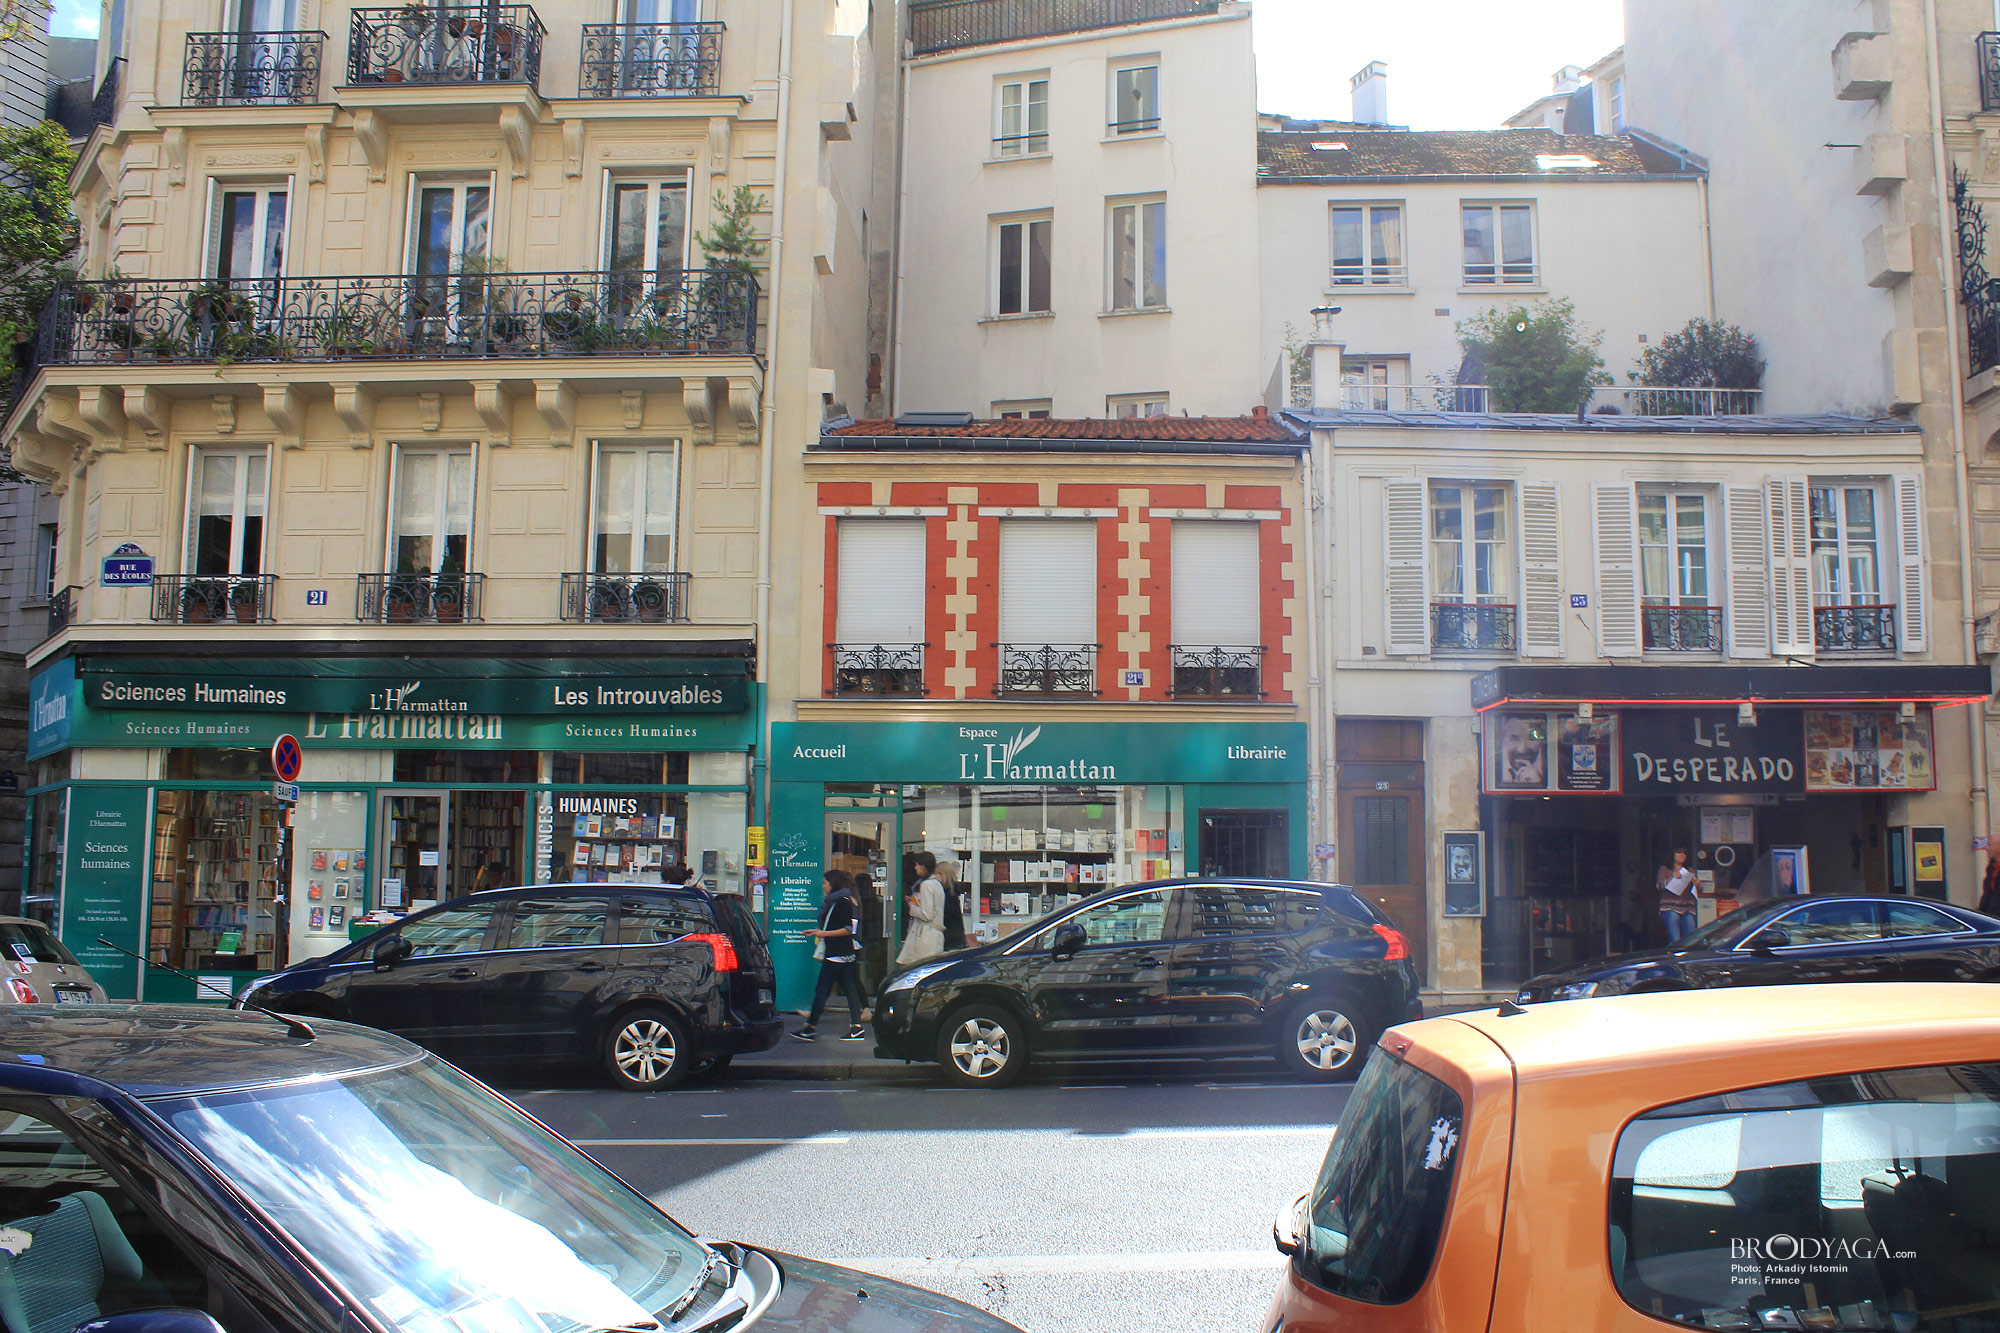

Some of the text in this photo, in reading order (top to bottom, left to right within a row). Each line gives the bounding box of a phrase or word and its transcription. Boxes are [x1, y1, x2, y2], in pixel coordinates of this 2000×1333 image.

[104, 570, 151, 580] DES ÉCOLES
[309, 591, 325, 604] 21
[101, 681, 287, 705] Sciences Humaines
[369, 687, 468, 712] L'Harmattan
[554, 684, 723, 706] Les Introuvables
[126, 721, 251, 735] Sciences Humaines
[304, 712, 503, 741] LHarmattan
[565, 723, 698, 738] Sciences Humaines
[959, 727, 998, 740] Espace
[1693, 716, 1731, 748] LE
[793, 744, 846, 758] Accueil
[1227, 745, 1288, 760] Librairie
[959, 743, 1116, 780] L'Harmattan
[1632, 752, 1794, 784] DESPERADO
[277, 785, 292, 796] SAUF
[559, 797, 638, 814] HUMAINES
[85, 841, 129, 853] Sciences
[536, 804, 554, 880] SCIENCES
[80, 857, 131, 869] humaines
[780, 876, 812, 885] Librairie
[19, 962, 31, 973] A
